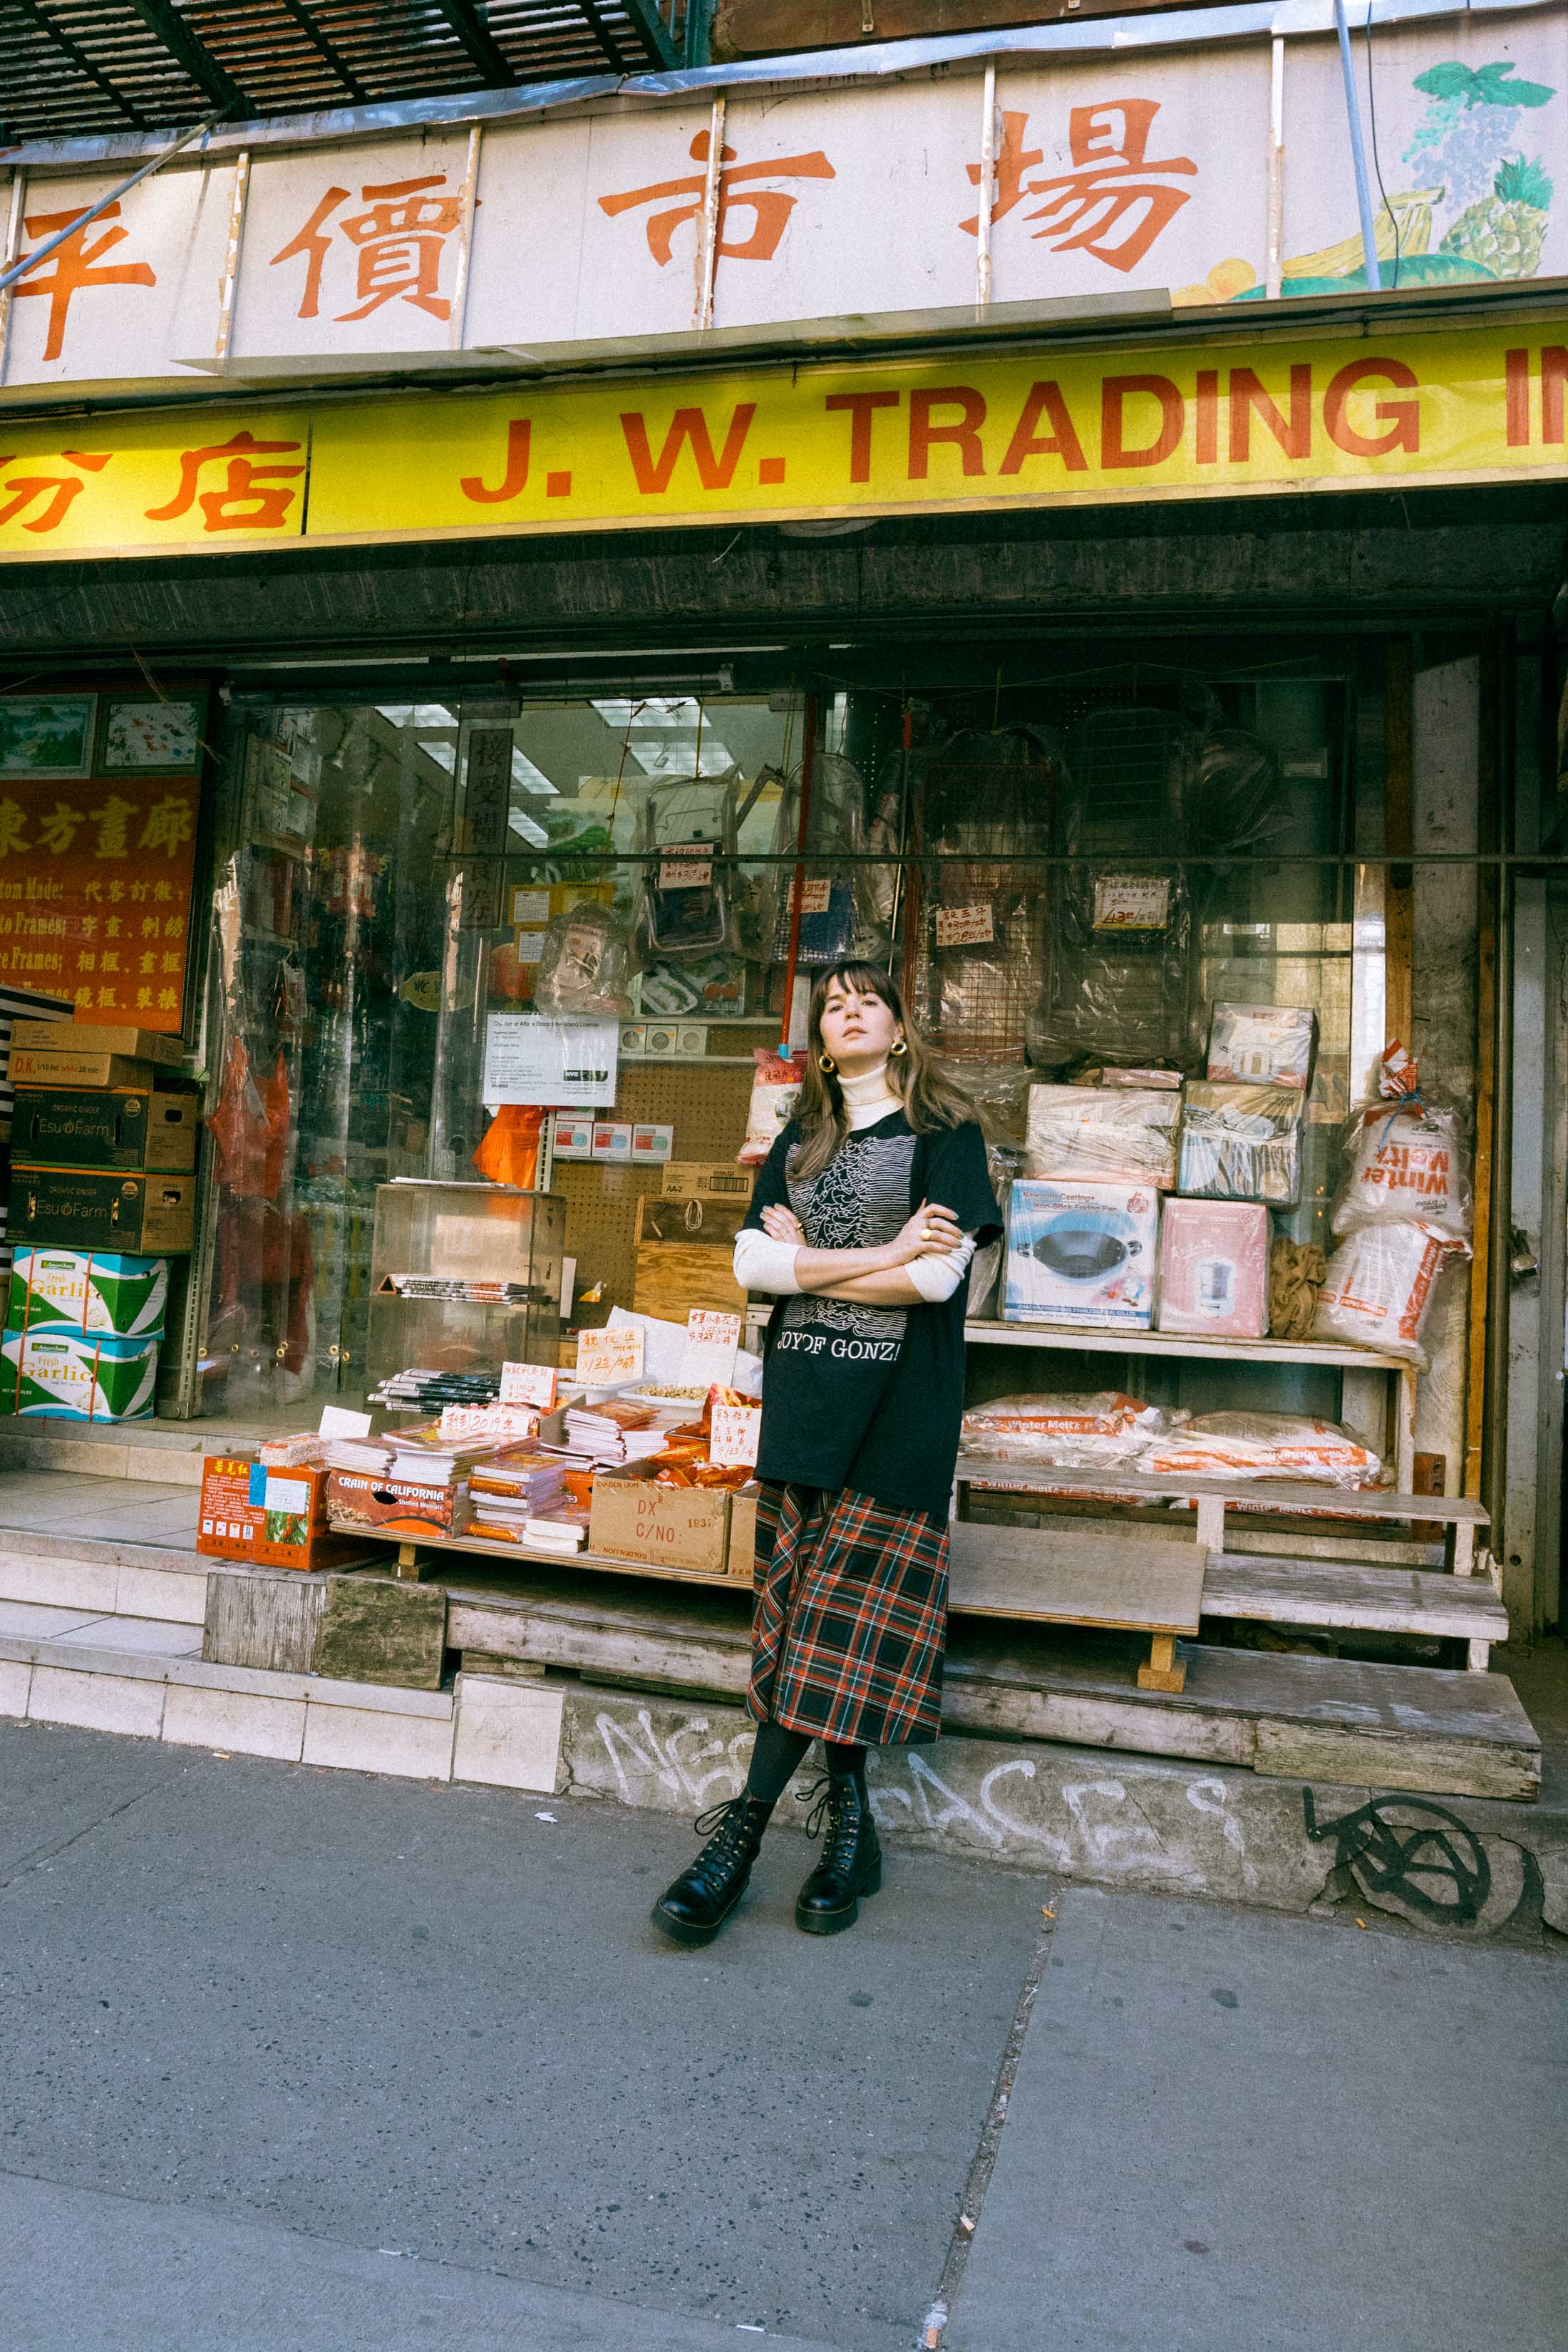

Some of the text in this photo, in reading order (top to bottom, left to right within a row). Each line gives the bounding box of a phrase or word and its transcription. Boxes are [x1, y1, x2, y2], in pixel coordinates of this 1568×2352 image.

[11, 98, 1199, 361] 平價市場
[461, 419, 572, 503] J.
[619, 403, 784, 494] W.
[825, 357, 1420, 483] TRADING
[1360, 1167, 1448, 1195] Winter
[29, 1279, 98, 1299] Garlic
[38, 1356, 60, 1366] Fresh
[21, 1362, 92, 1381] Garlic
[338, 1476, 445, 1502] CRAIN OF CALIFORNIA
[398, 1499, 418, 1507] Shelled
[638, 1499, 656, 1516] DX
